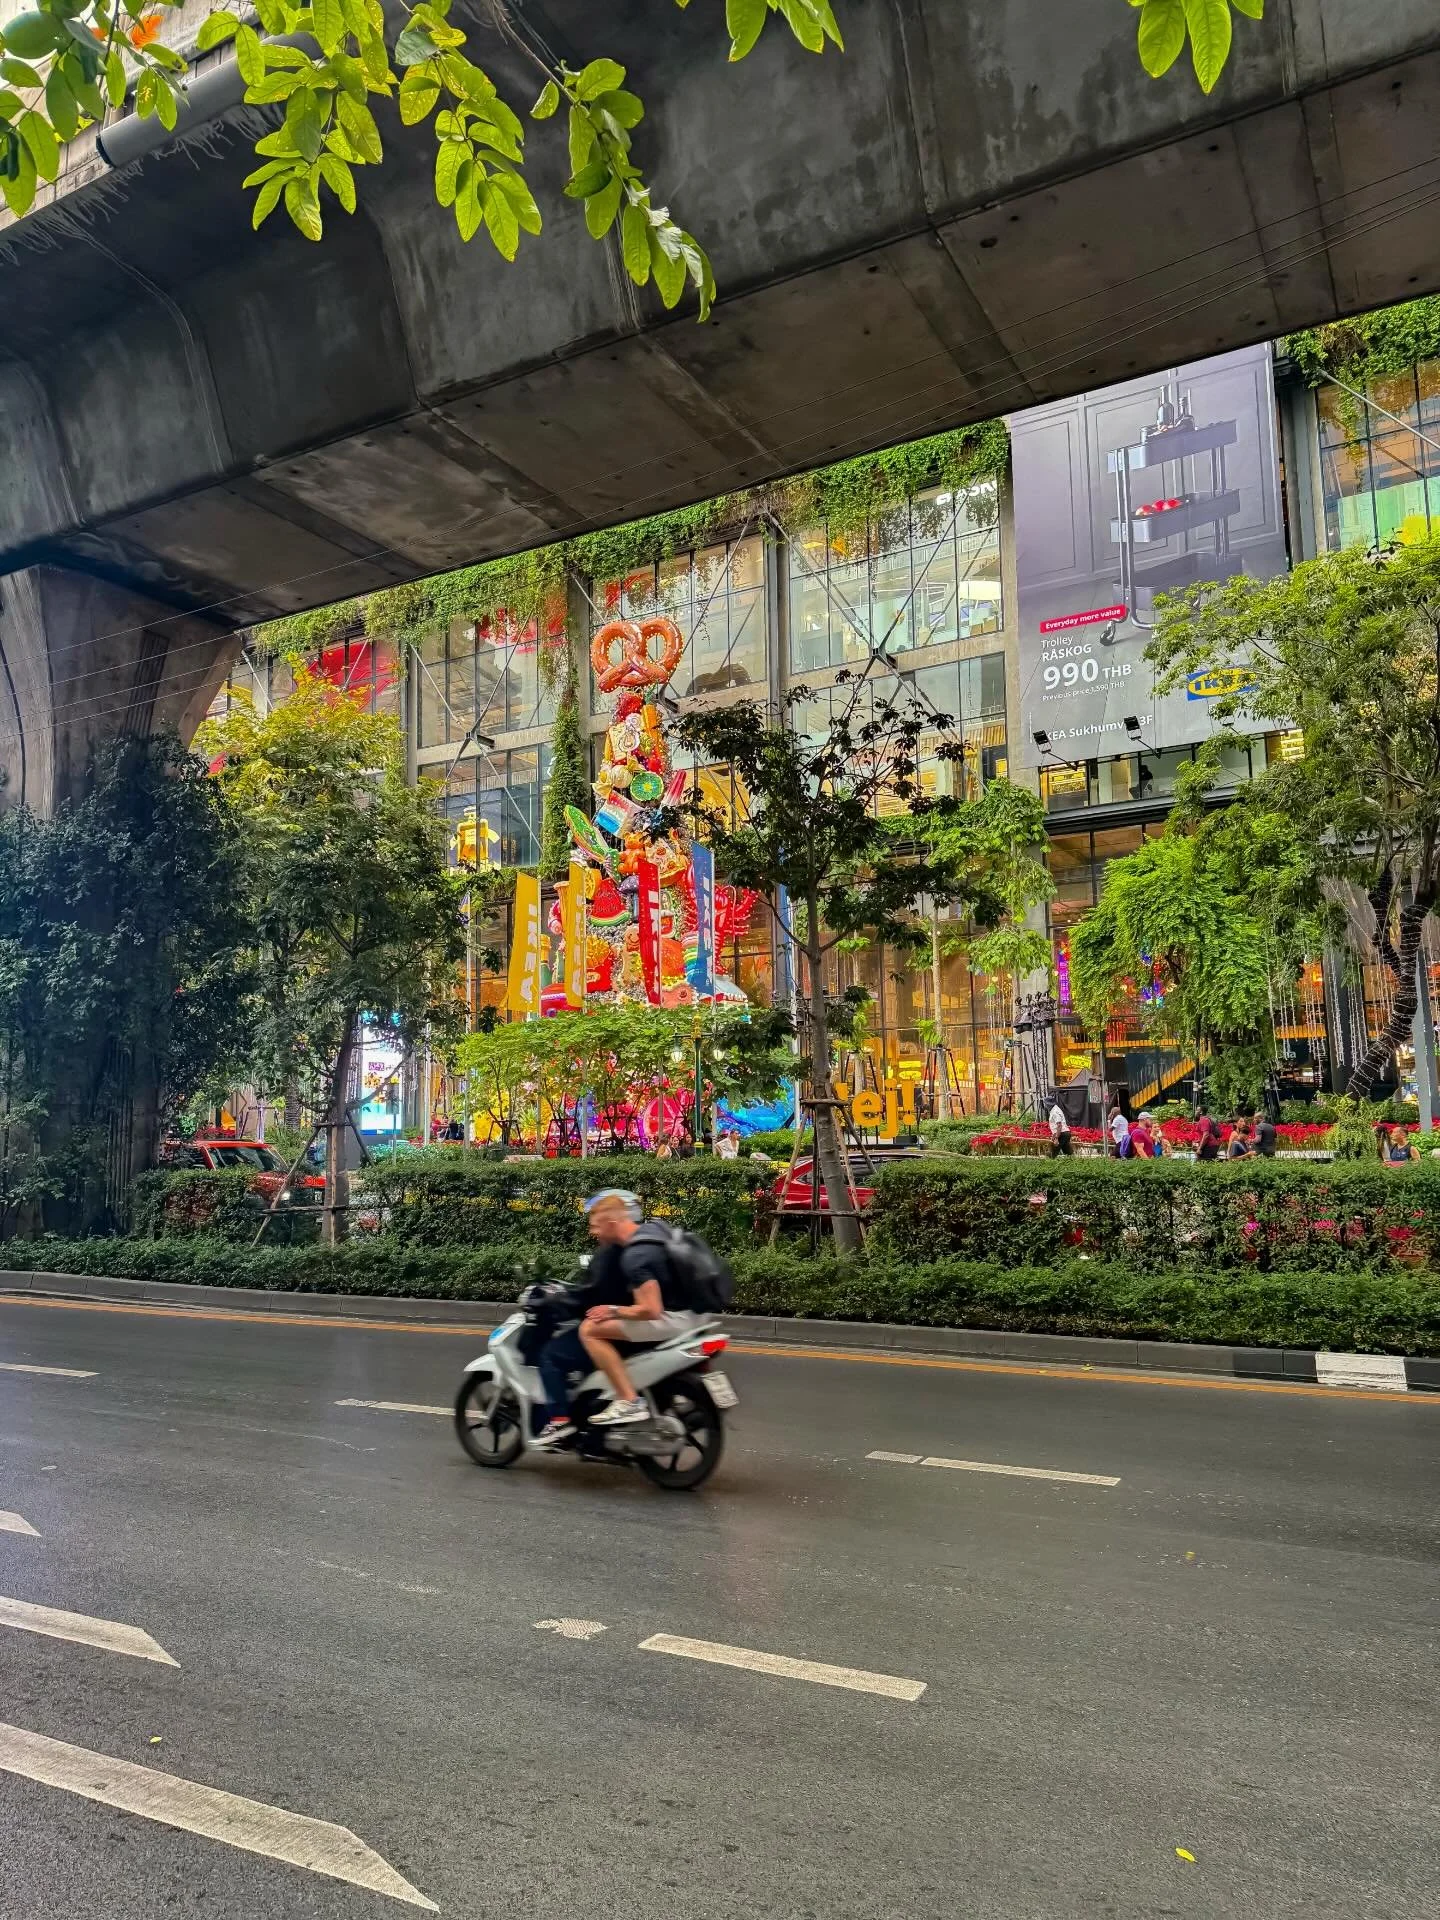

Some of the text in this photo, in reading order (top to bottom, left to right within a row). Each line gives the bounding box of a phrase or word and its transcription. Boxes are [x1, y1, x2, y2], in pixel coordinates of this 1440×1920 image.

[1045, 608, 1121, 630] Everyday more value
[1041, 635, 1073, 648] Trolley
[1042, 643, 1092, 662] RÅSKOG
[1043, 658, 1132, 691] 990 THB
[1110, 681, 1125, 689] THB
[1047, 715, 1153, 740] KEA Sukhumv 3F
[834, 1079, 916, 1139] ej!
